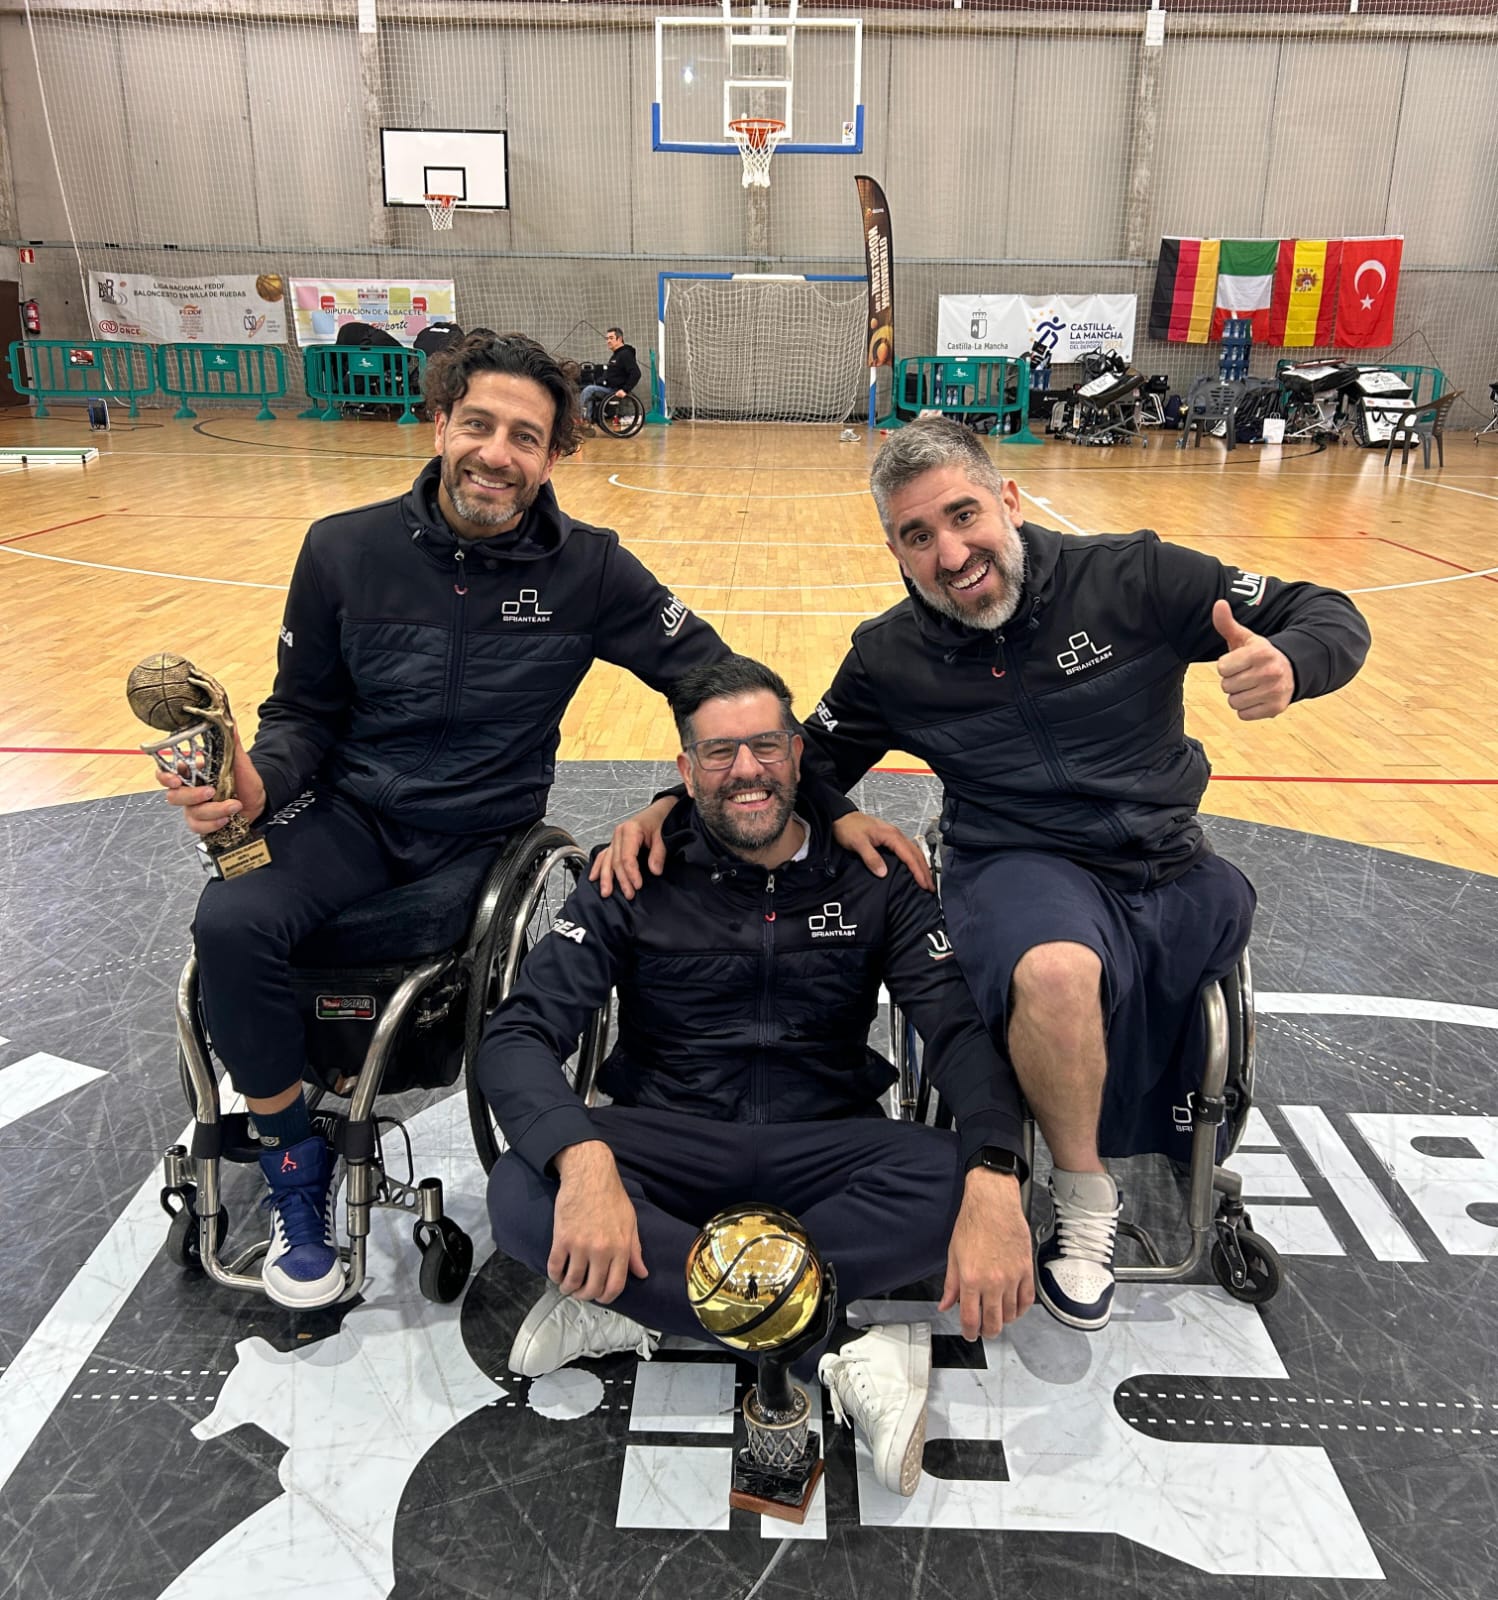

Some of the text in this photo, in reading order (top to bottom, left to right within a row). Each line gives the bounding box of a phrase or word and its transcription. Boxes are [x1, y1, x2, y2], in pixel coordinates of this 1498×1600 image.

[133, 289, 178, 299] BALONCESTO
[383, 308, 422, 316] ALBACETE
[1070, 323, 1116, 331] CASTILLA-
[1070, 331, 1123, 340] LA MANCHA
[984, 342, 1009, 350] Mancha
[502, 615, 551, 623] BRIANTEA84
[1065, 651, 1113, 676] BRIANTEA84
[811, 930, 856, 938] BRIANTEA84
